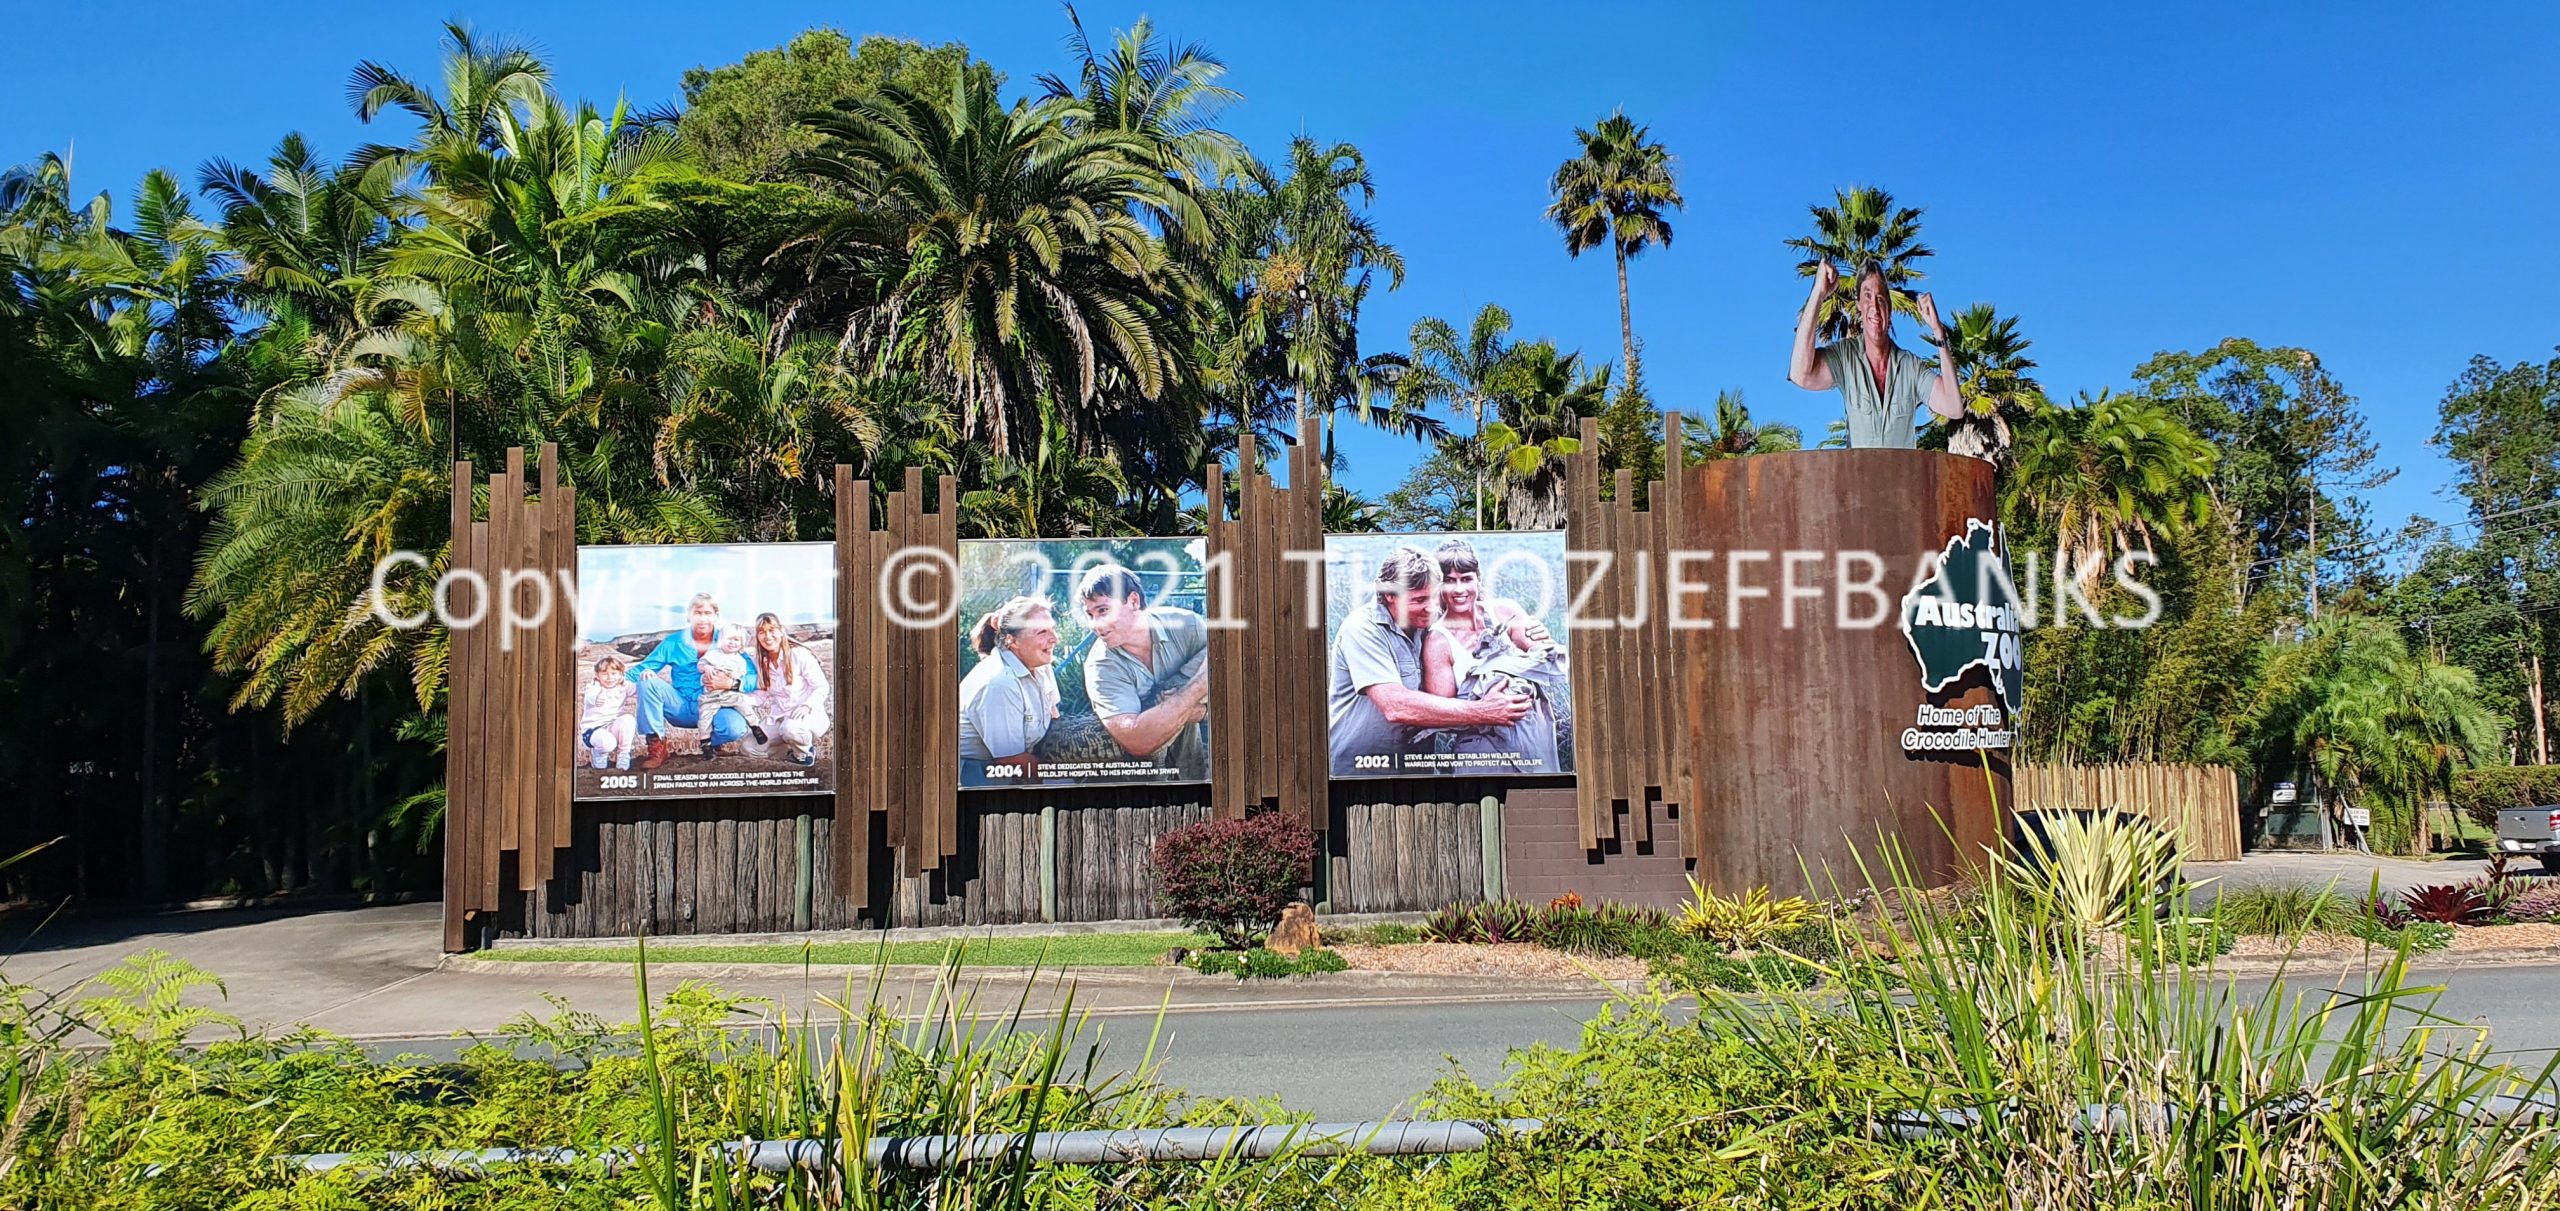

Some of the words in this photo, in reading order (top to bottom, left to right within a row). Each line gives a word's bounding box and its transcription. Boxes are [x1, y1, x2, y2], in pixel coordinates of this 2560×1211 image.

[1918, 704, 1964, 725] Home
[1967, 705, 1980, 725] of
[1981, 706, 2000, 724] The
[1903, 730, 1976, 748] Crocodile
[1978, 730, 2011, 747] Hunter
[1457, 752, 1490, 760] ESTABLISH
[1491, 751, 1520, 759] WILDLIFE
[1057, 762, 1091, 770] DEDICATES
[1105, 761, 1139, 769] AUSTRALIA
[1354, 754, 1390, 769] 2002
[1404, 760, 1436, 768] WARRIORS
[1512, 758, 1543, 766] WILDLIFE
[653, 774, 673, 782] FINAL
[674, 773, 698, 781] SEASON
[708, 772, 745, 780] CROCODILE
[745, 771, 771, 779] HUNTER
[986, 764, 1022, 778] 2004
[1037, 770, 1068, 778] WILDLIFE
[1121, 768, 1146, 776] MOTHER
[1159, 767, 1179, 775] IRWIN
[600, 775, 637, 789] 2005
[699, 780, 708, 788] ON
[709, 780, 719, 788] AN
[719, 779, 781, 788] ACROSS-THE-WORLD
[782, 777, 819, 785] ADVENTURE
